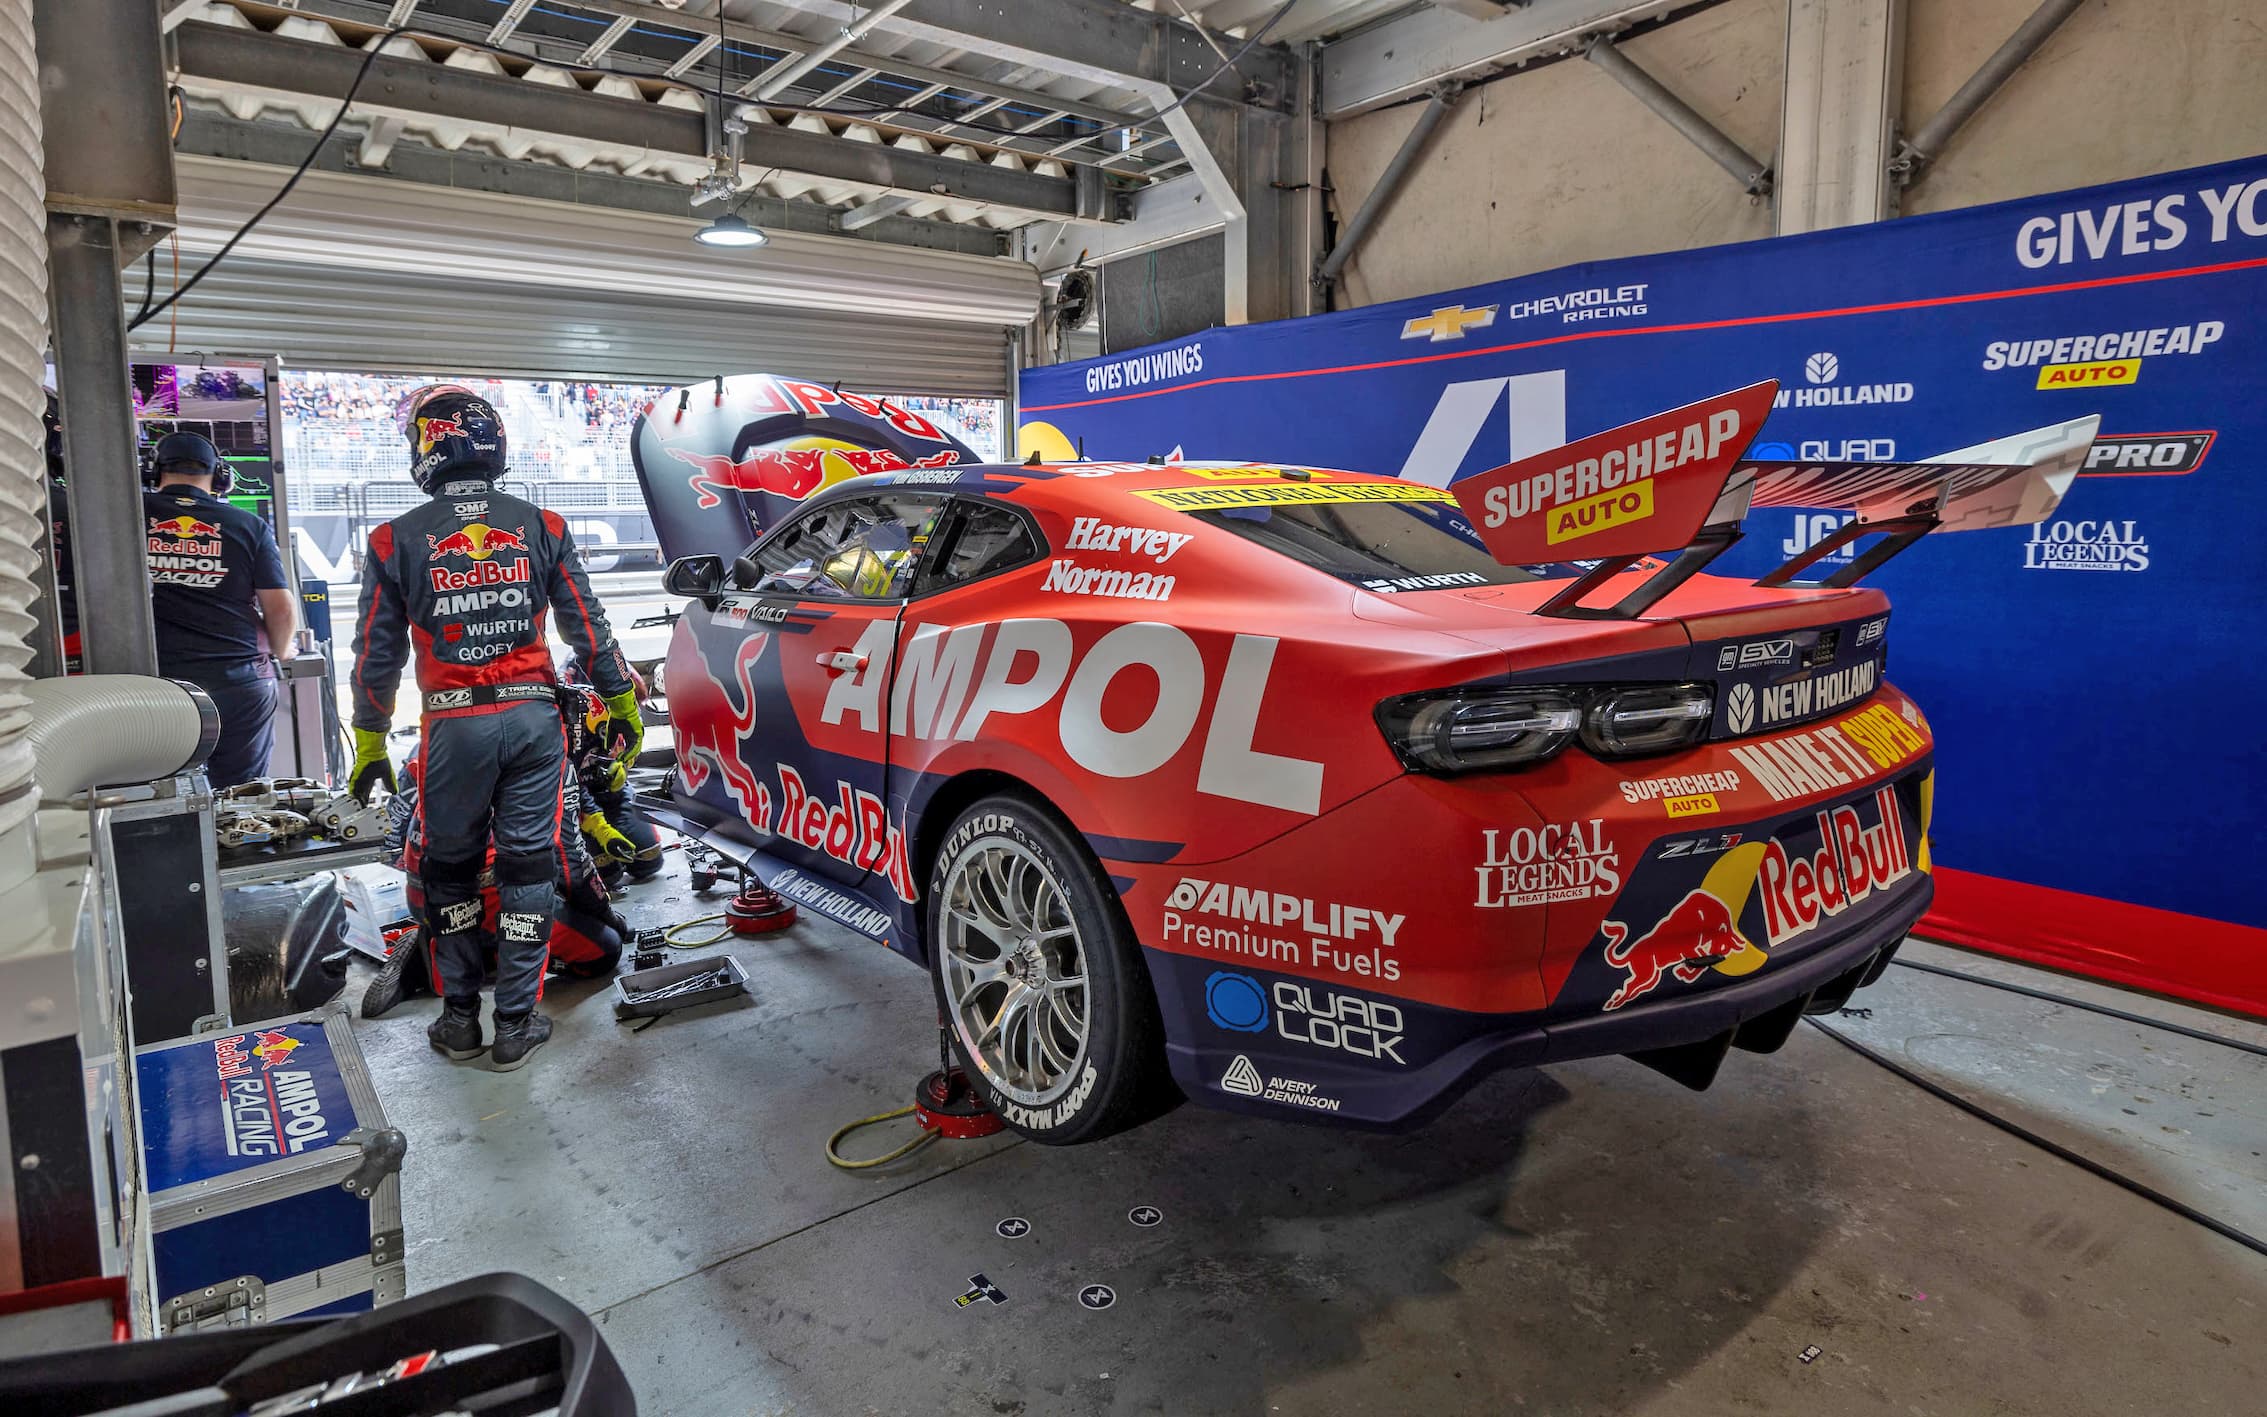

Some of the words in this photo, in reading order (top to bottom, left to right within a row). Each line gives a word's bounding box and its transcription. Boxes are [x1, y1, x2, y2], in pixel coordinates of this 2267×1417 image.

[2016, 194, 2187, 269] GIVES
[1510, 284, 1648, 319] CHEVROLET
[1563, 304, 1647, 323] RACING
[1983, 320, 2224, 371] SUPERCHEAP
[1086, 362, 1122, 393] GIVES
[1123, 354, 1150, 386] YOU
[1150, 343, 1203, 381] WINGS
[2047, 365, 2127, 384] AUTO
[1795, 382, 1914, 407] HOLLAND
[413, 450, 448, 479] AMPOL
[473, 442, 497, 452] Gooey
[1800, 438, 1895, 462] QUAD
[1484, 408, 1740, 528] SUPERCHEAP
[454, 503, 489, 513] OMP
[1151, 485, 1338, 506] NATIONAL
[1556, 492, 1641, 534] AUTO
[148, 538, 183, 554] Red
[187, 541, 222, 557] Bull
[1065, 516, 1194, 562] Harvey
[2030, 520, 2144, 544] LOCAL
[2023, 542, 2149, 571] LEGENDS
[430, 561, 482, 592] Red
[483, 557, 531, 585] Bull
[1040, 559, 1176, 601] Norman
[1391, 571, 1488, 591] WÜRTH
[432, 588, 533, 617] AMPOL
[751, 605, 788, 623] VAILO
[467, 619, 529, 637] WÜRTH
[458, 641, 514, 662] GOOEY
[1762, 680, 1813, 724] NEW
[1815, 660, 1875, 712] HOLLAND
[820, 618, 1324, 816] AMPOL
[1813, 725, 1876, 780] IT
[1839, 703, 1925, 769] SUPER
[1728, 734, 1852, 801] MAKE
[1619, 770, 1740, 804] SUPERCHEAP
[777, 762, 853, 865] Red
[1672, 798, 1712, 812] AUTO
[938, 814, 1014, 879] DUNLOP
[1482, 819, 1614, 867] LOCAL
[1657, 832, 1743, 860] ZL1
[1474, 854, 1620, 907] LEGENDS
[1759, 809, 1847, 948] Red
[1834, 784, 1911, 906] Bull
[785, 877, 817, 904] NEW
[818, 890, 893, 936] HOLLAND
[1517, 893, 1544, 903] MEAT
[1547, 889, 1584, 900] SNACKS
[1198, 882, 1406, 947] AMPLIFY
[1163, 911, 1300, 964] Premium
[1311, 938, 1401, 982] Fuels
[1273, 981, 1404, 1033] QUAD
[214, 1035, 249, 1060] Red
[1276, 1010, 1407, 1065] LOCK
[218, 1050, 253, 1081] Bull
[1055, 1057, 1097, 1127] SPORT
[1263, 1090, 1340, 1111] DENNISON
[1268, 1077, 1317, 1095] AVERY
[229, 1078, 279, 1157] RACING
[273, 1071, 329, 1154] AMPOL
[1003, 1101, 1053, 1130] MAXX
